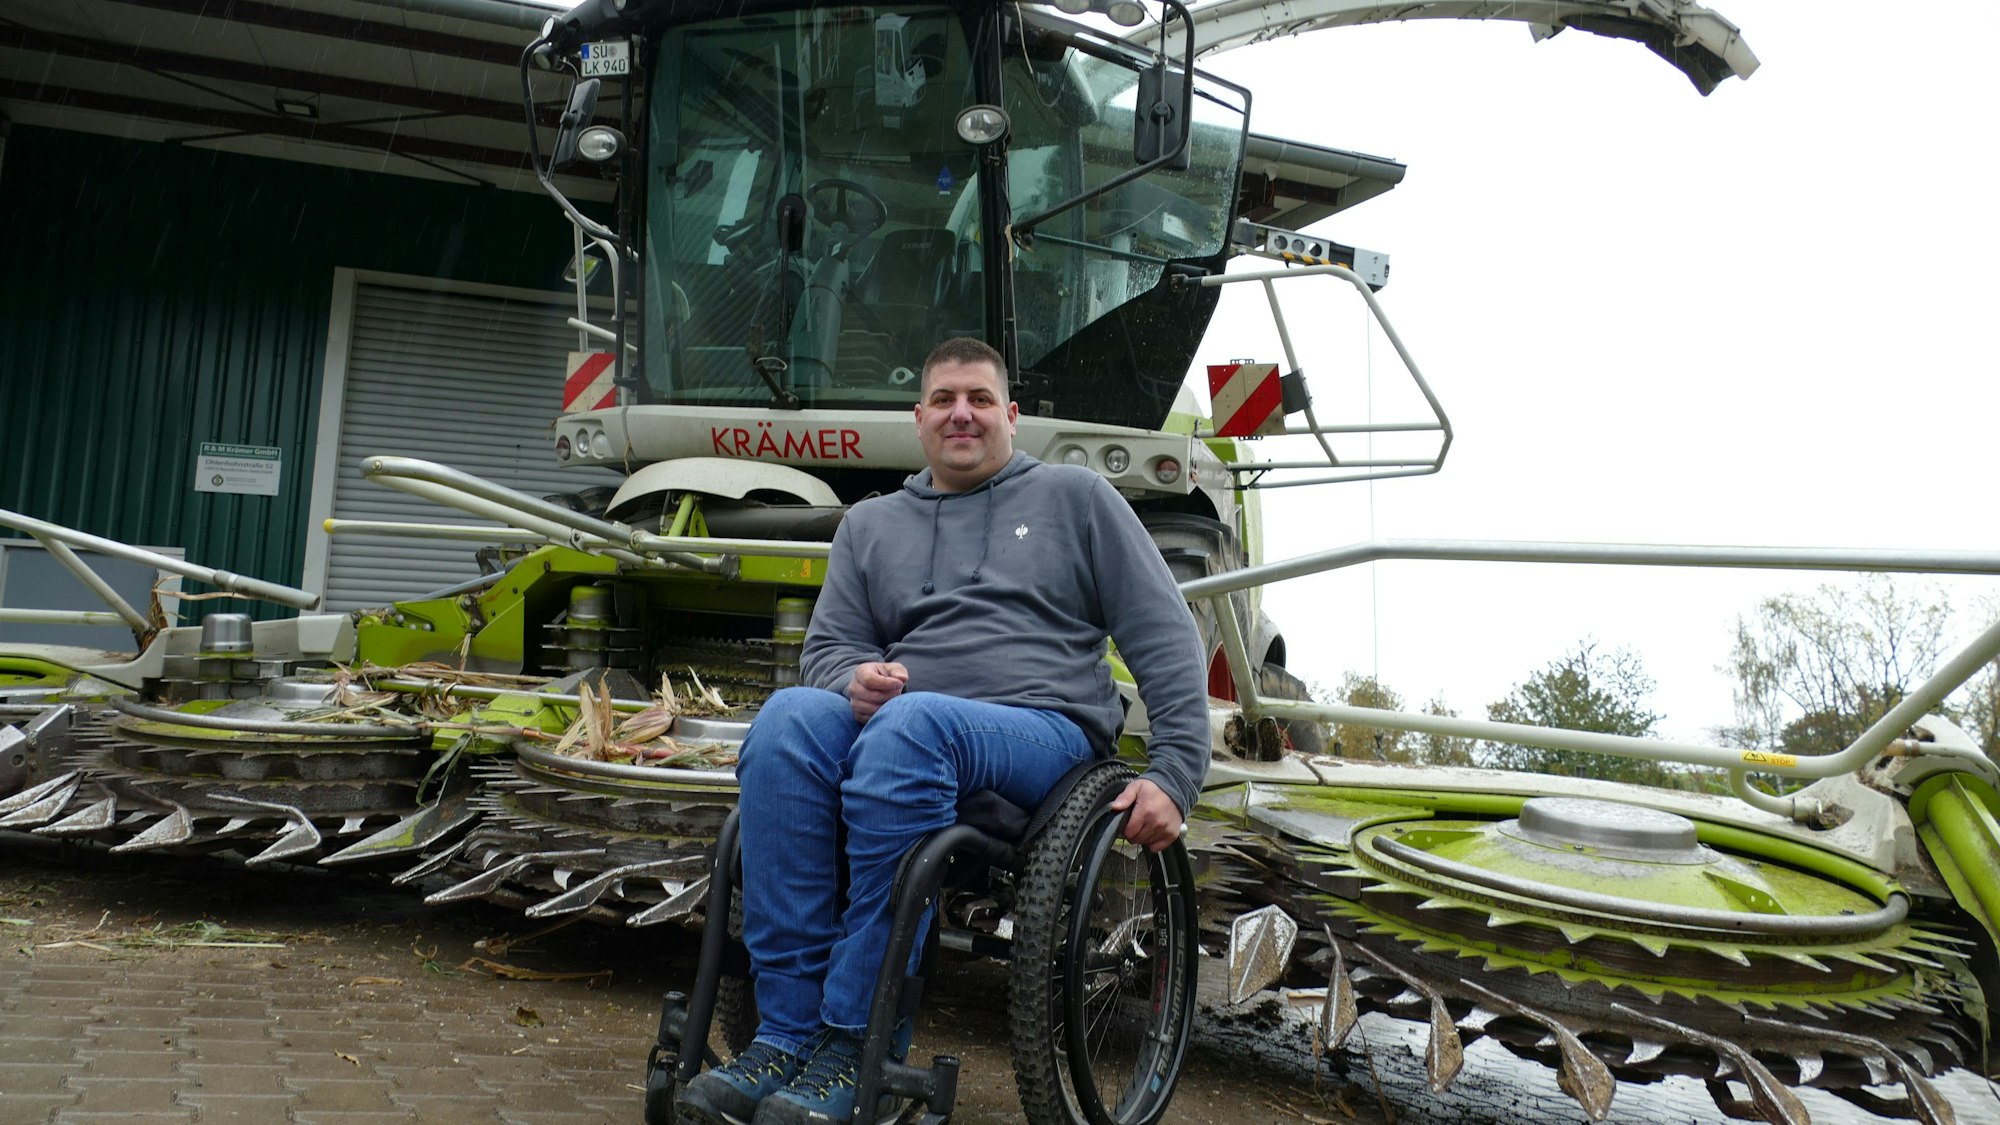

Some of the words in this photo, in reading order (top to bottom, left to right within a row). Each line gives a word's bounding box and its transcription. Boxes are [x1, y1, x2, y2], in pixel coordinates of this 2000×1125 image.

[593, 45, 607, 59] SU
[585, 61, 600, 74] LK
[604, 59, 625, 73] 940
[711, 421, 864, 459] KRÄMER
[227, 446, 253, 455] Krämer
[254, 448, 278, 456] GmbH
